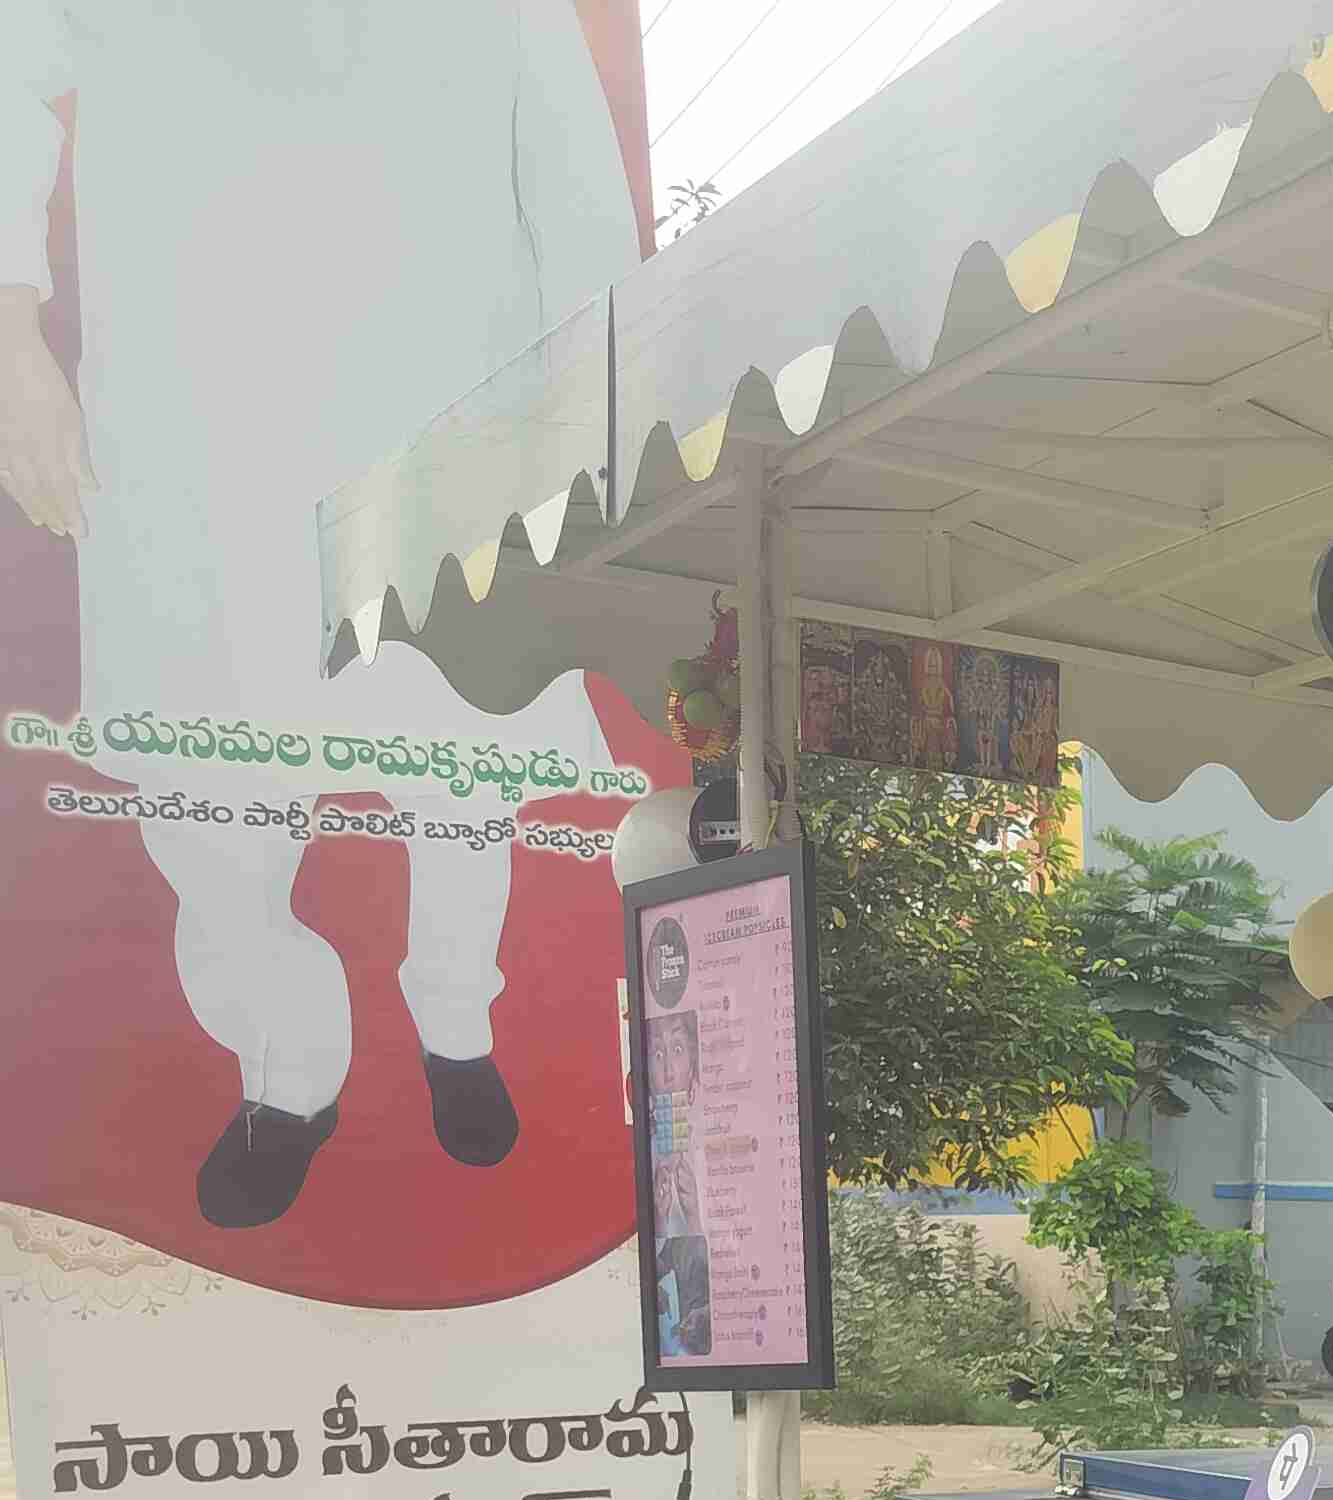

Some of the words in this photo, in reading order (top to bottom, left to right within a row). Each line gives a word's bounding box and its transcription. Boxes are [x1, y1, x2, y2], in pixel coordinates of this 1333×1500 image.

[103, 711, 312, 767] యనమల
[323, 735, 580, 804] రామకృష్ణుడు
[590, 768, 647, 795] గారు
[48, 786, 234, 824] తెలుగుదేశం
[243, 801, 311, 841] పార్టీ
[53, 1423, 299, 1493] సాయి
[322, 1382, 694, 1476] సీతారామ
